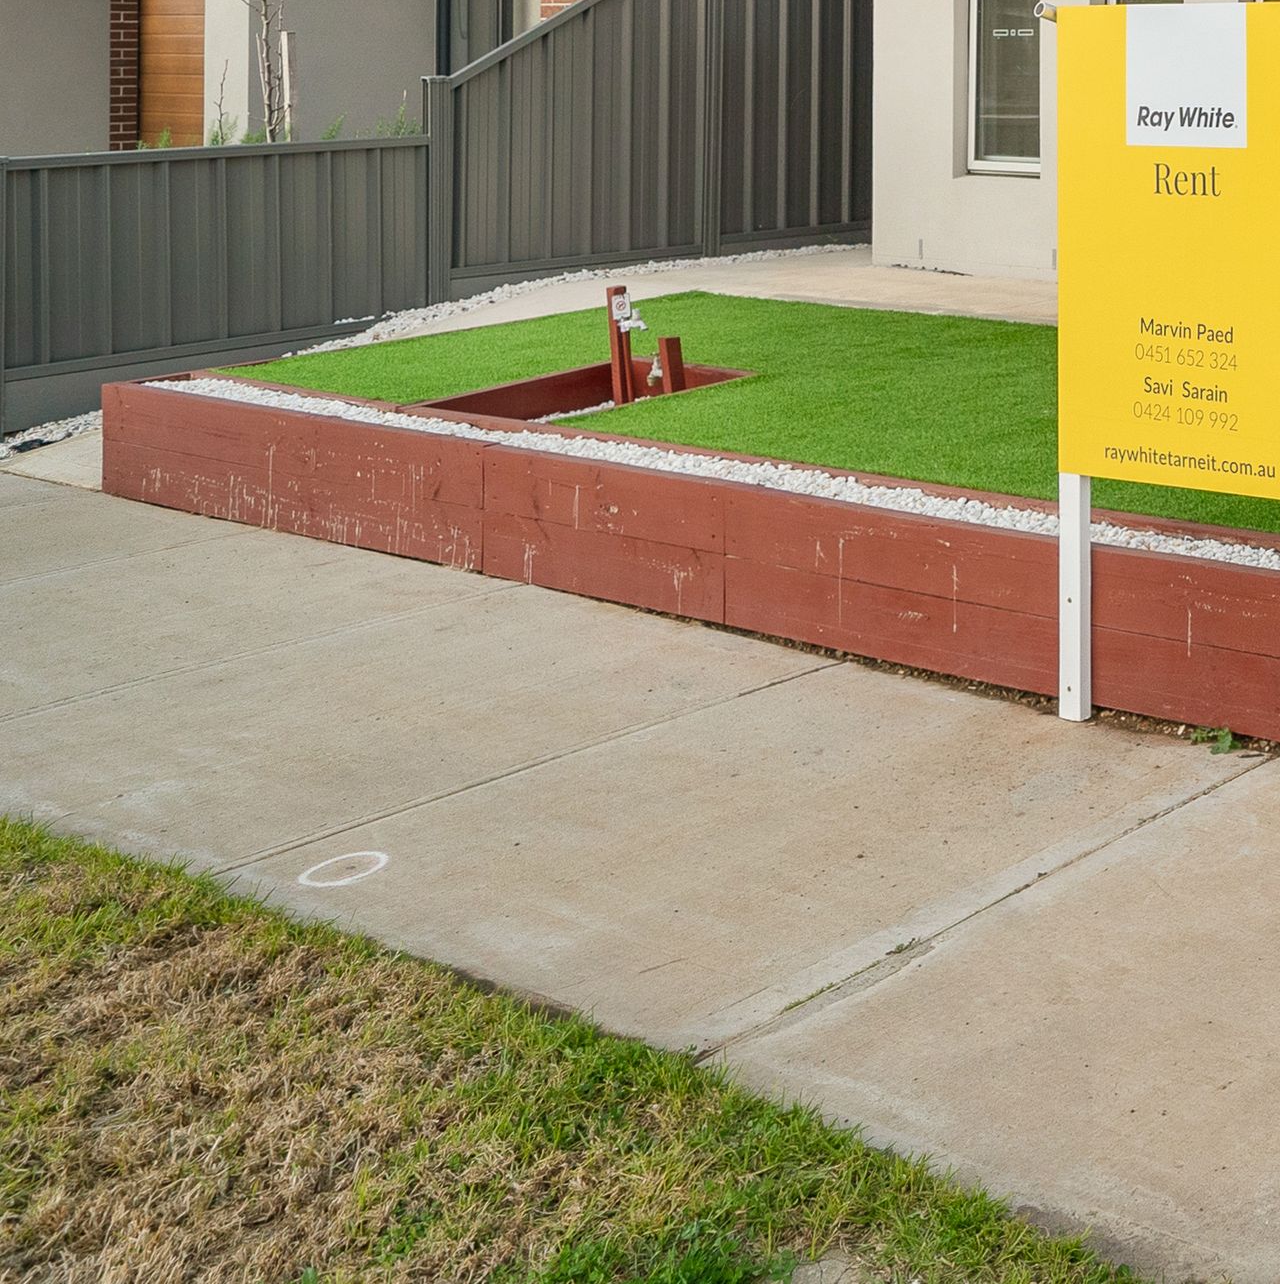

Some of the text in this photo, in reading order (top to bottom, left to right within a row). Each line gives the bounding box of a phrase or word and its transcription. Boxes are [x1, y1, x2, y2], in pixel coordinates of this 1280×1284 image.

[1137, 106, 1235, 131] Ray White
[1154, 163, 1221, 197] Rent
[1140, 317, 1233, 344] Marvin Paed
[1135, 343, 1238, 371] 0451 652 324
[1144, 376, 1228, 403] Savi Sarain
[1133, 401, 1238, 431] 0424 109 992
[1104, 446, 1276, 478] raywhitetarneit.com.au
